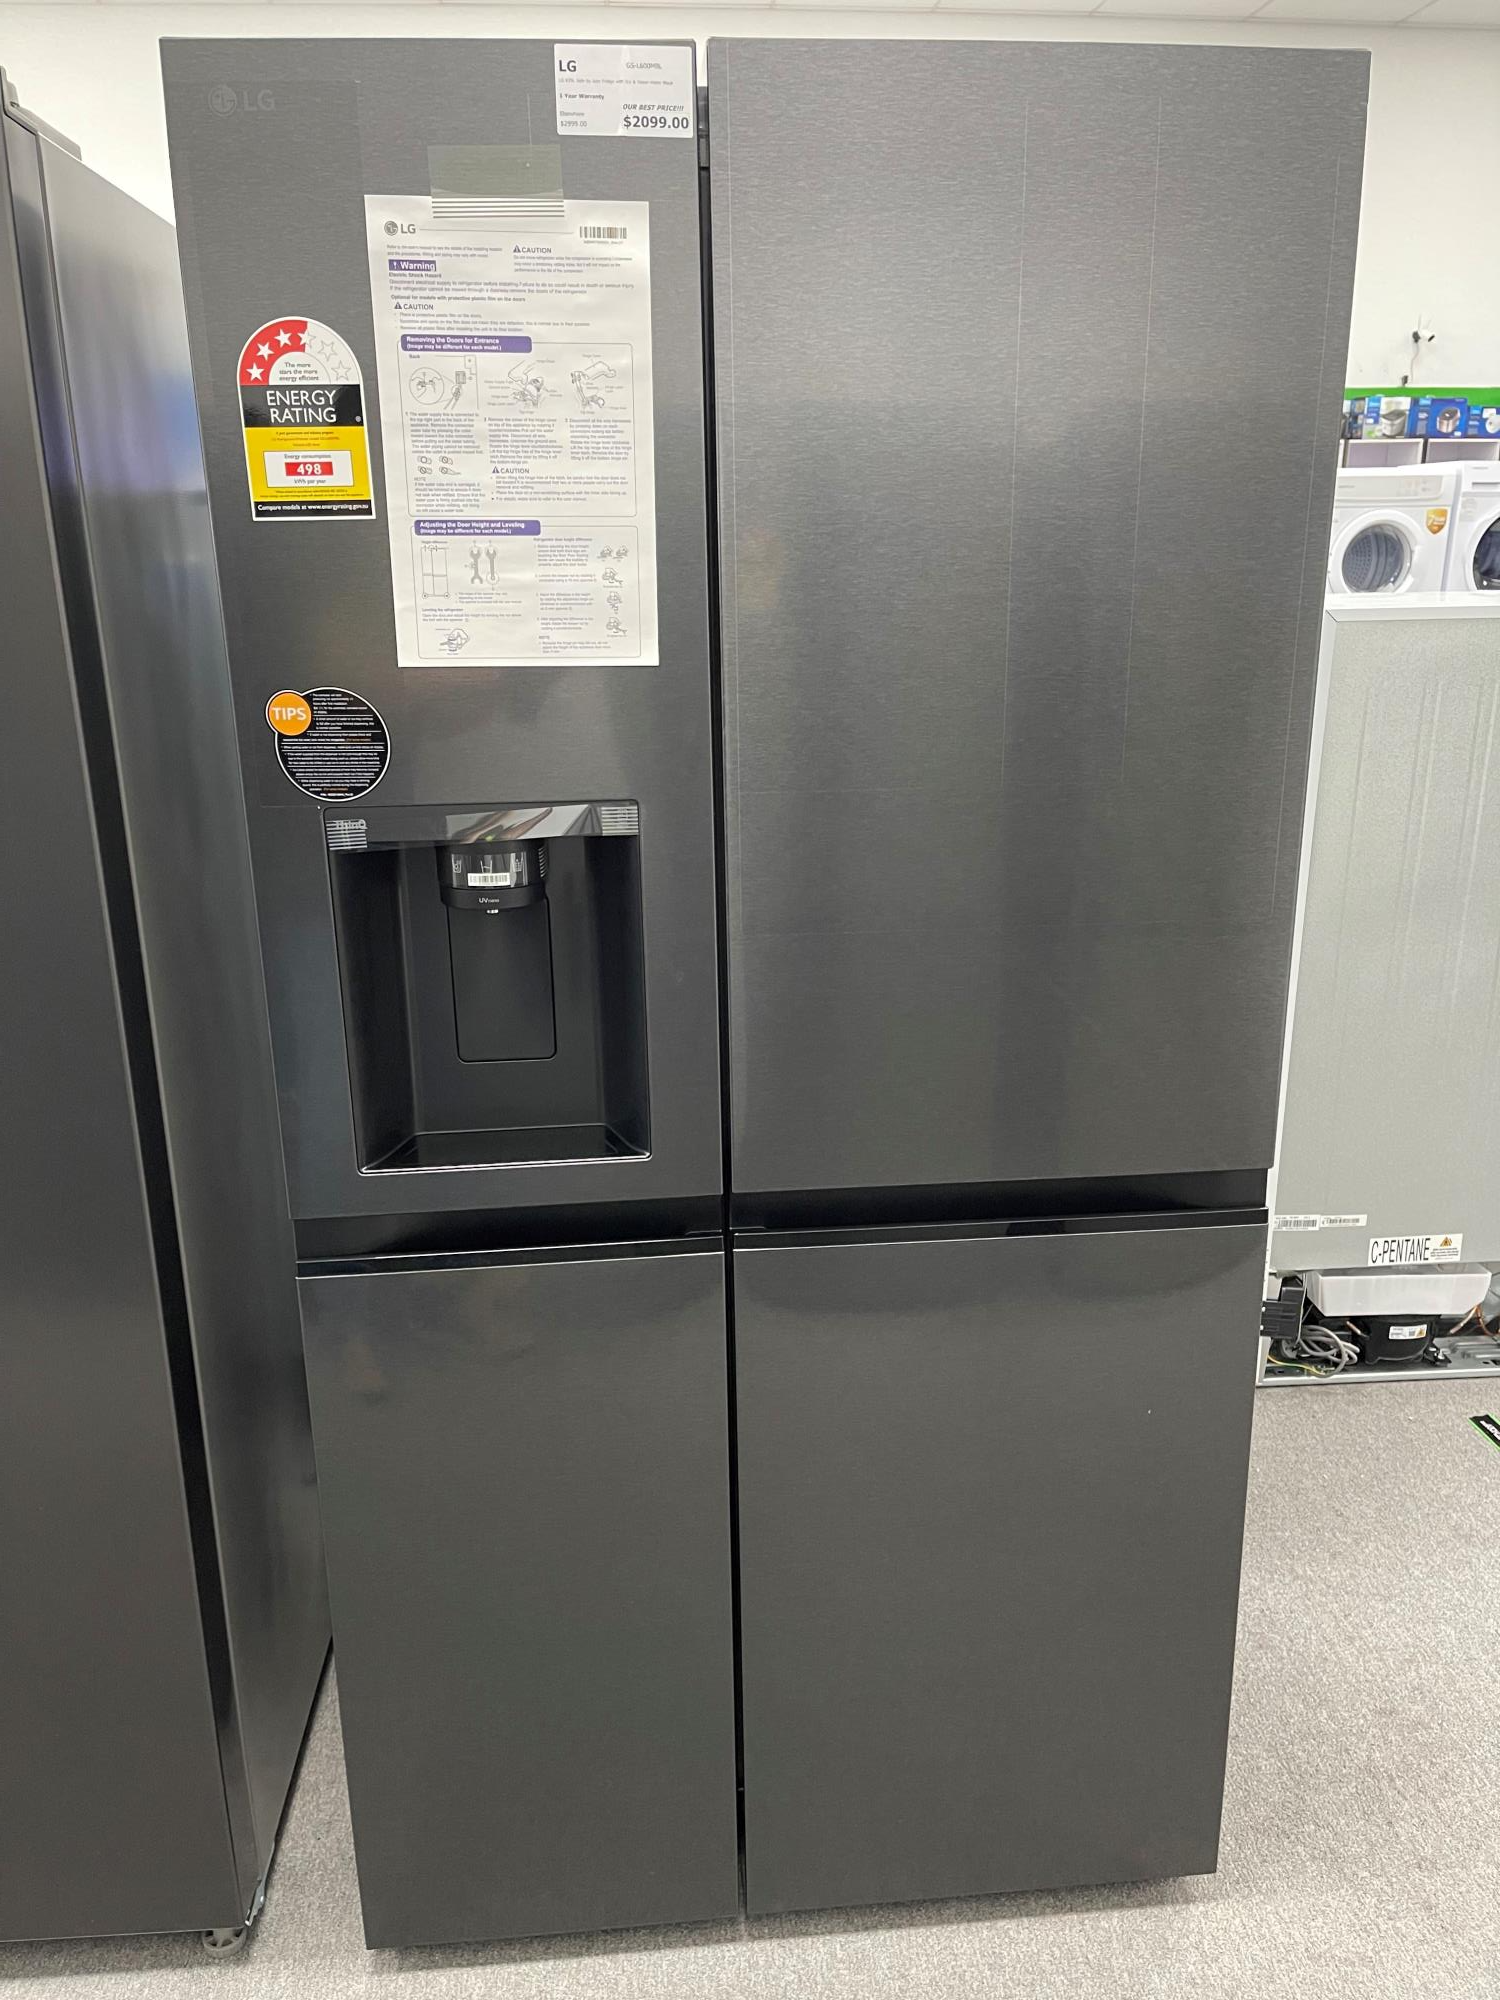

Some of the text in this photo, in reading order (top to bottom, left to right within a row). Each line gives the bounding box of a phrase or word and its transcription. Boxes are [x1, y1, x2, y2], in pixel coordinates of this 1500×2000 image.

[559, 60, 577, 72] LG
[244, 88, 274, 111] LG
[624, 115, 689, 129] $2099.00
[401, 224, 416, 234] LG
[400, 262, 436, 271] Warning
[266, 390, 336, 405] ENERGY
[270, 408, 337, 423] RATING
[297, 464, 321, 475] 498
[273, 707, 307, 720] TIPS
[1371, 1238, 1431, 1263] C-PENTANE
